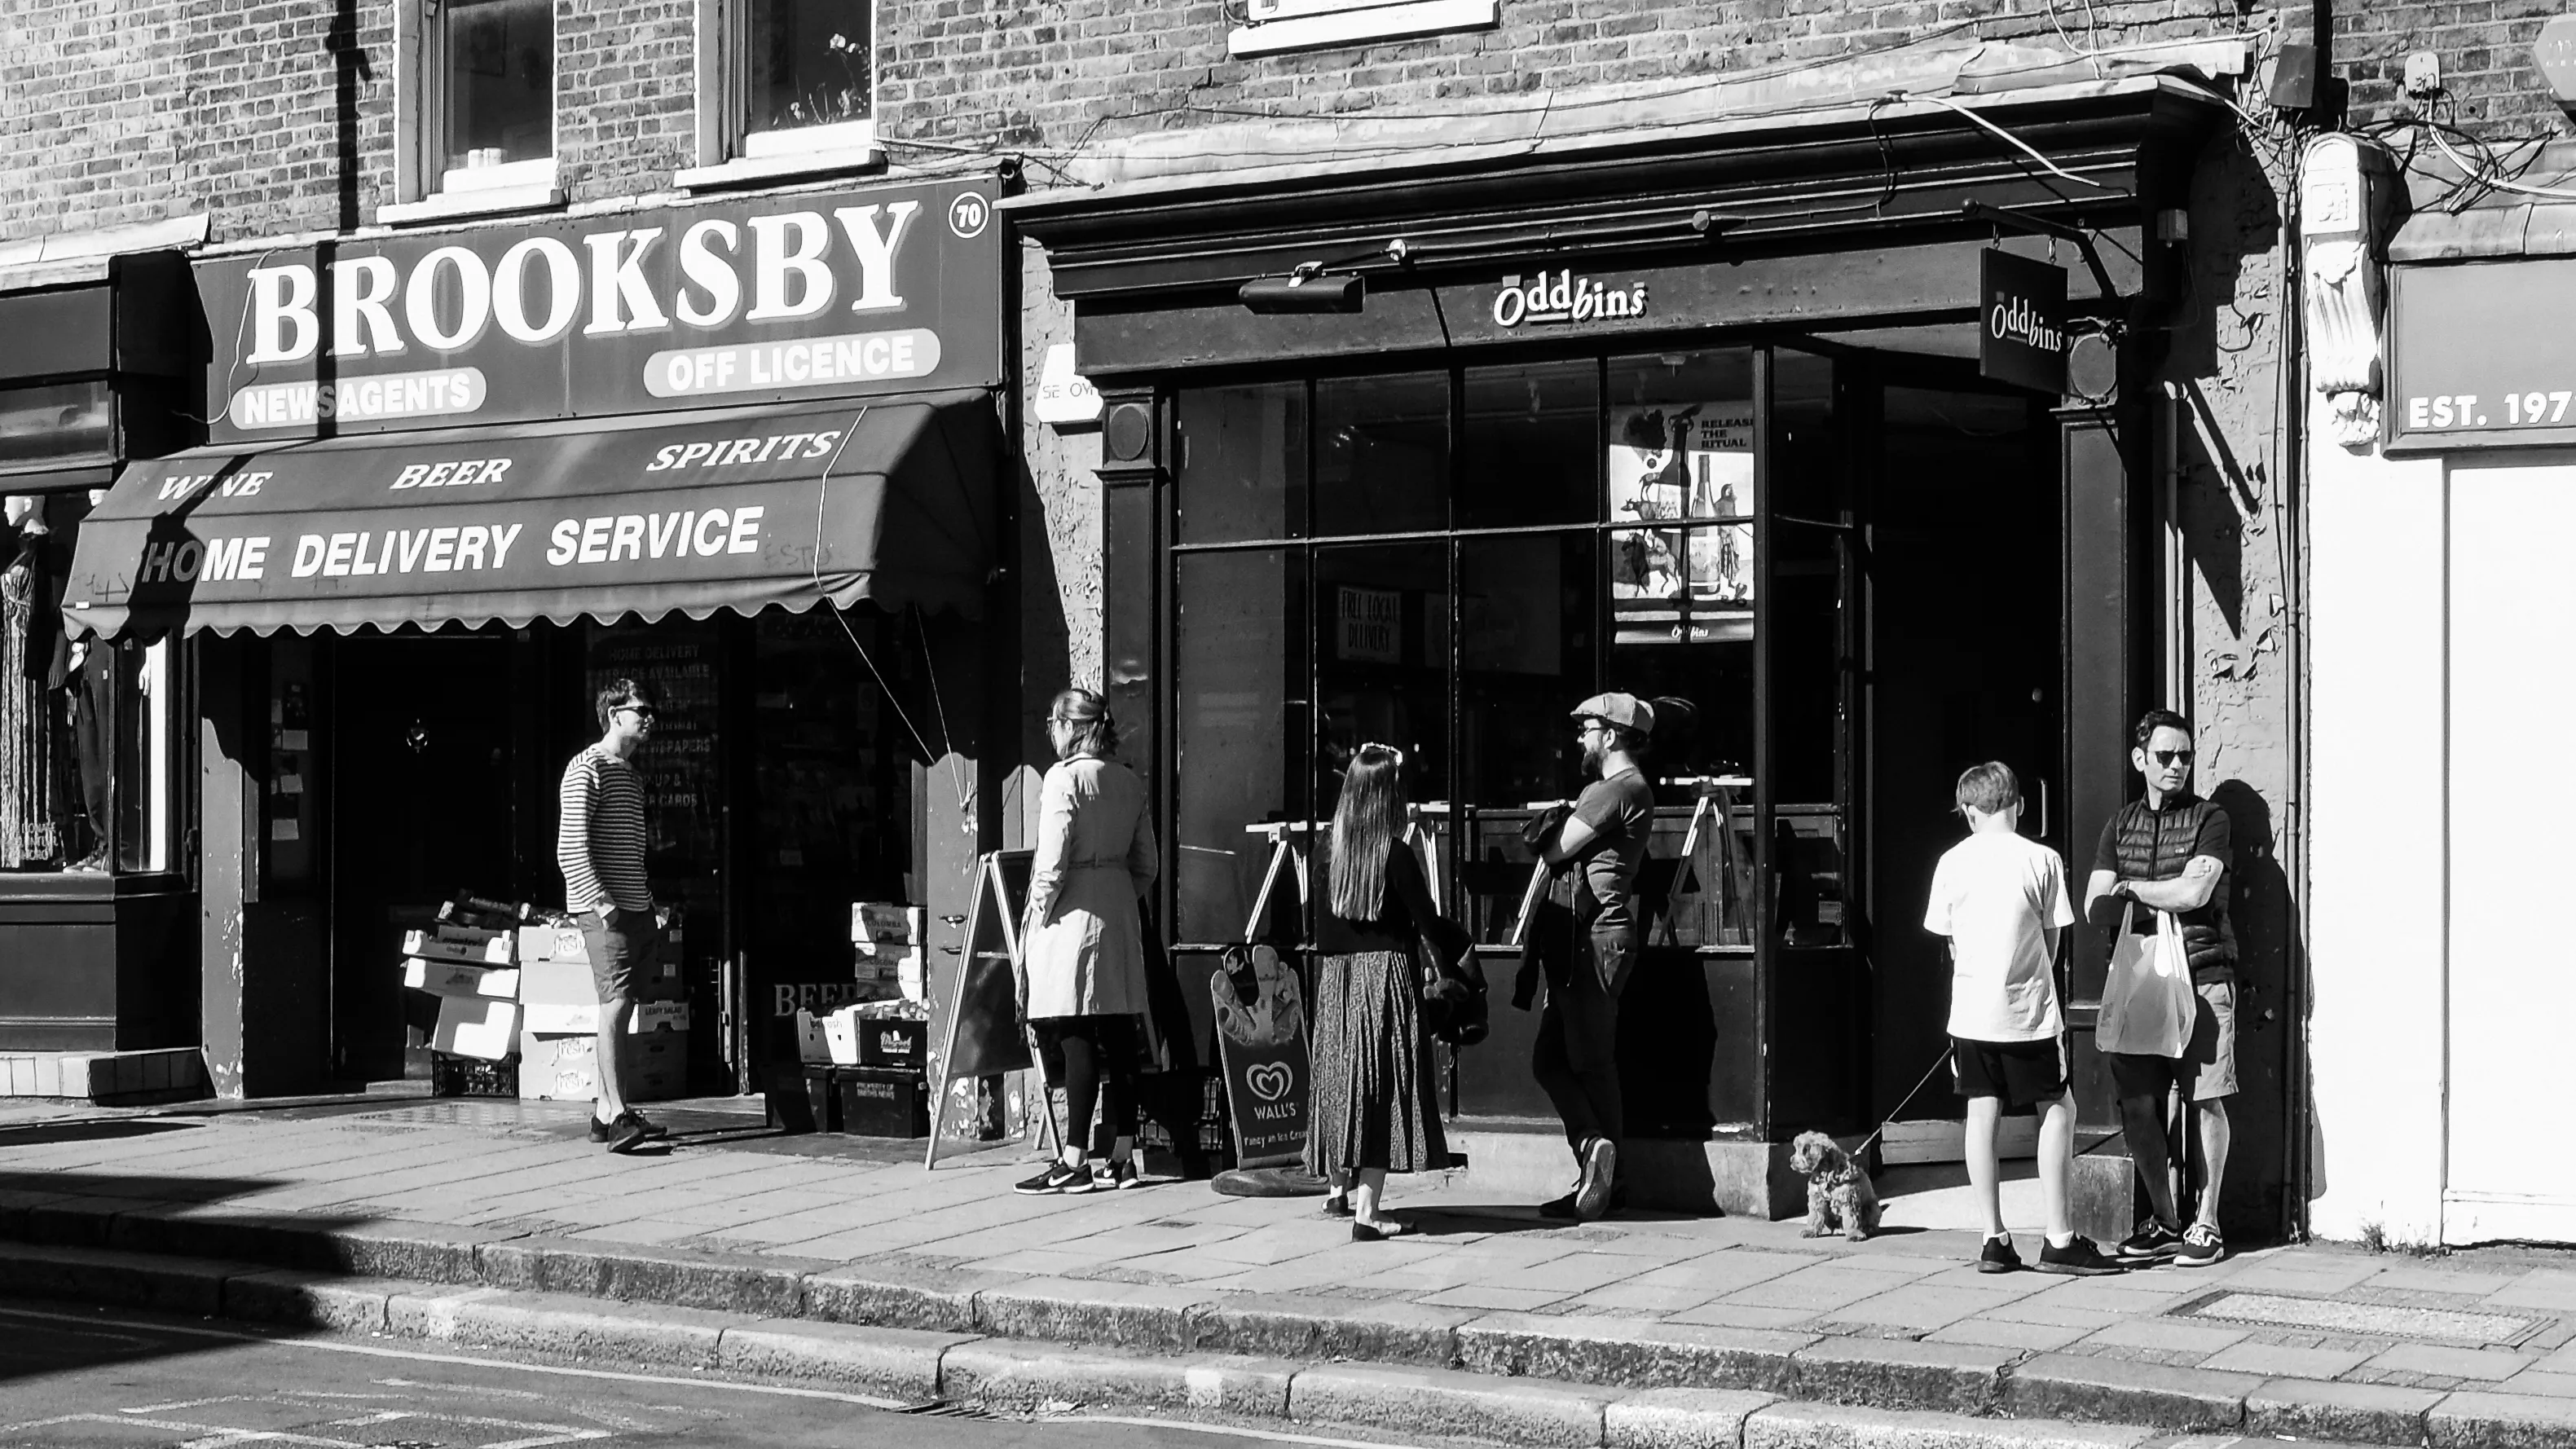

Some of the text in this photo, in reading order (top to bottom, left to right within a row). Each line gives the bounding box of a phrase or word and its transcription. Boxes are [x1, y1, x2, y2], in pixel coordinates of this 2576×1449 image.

[957, 205, 981, 227] 70
[246, 200, 922, 366] BROOKSBY
[1494, 269, 1646, 326] Oddbins
[1991, 295, 2063, 352] Oddbins
[667, 336, 914, 391] OFF LICENCE
[244, 373, 470, 425] NEWSAGENTS
[2409, 390, 2576, 428] EST. 197
[1701, 429, 1727, 438] THE
[1701, 438, 1746, 448] RITUAL
[390, 458, 513, 490] BEER
[645, 430, 841, 471] SPIRITS
[141, 506, 764, 583] HOME DELIVERY SERVICE
[1341, 591, 1398, 623] FREE LOCAL
[645, 644, 699, 659] DELIVERY
[1348, 623, 1390, 652] DELIVERY
[1253, 1102, 1297, 1120] WALL'S
[1289, 1130, 1308, 1140] Crea
